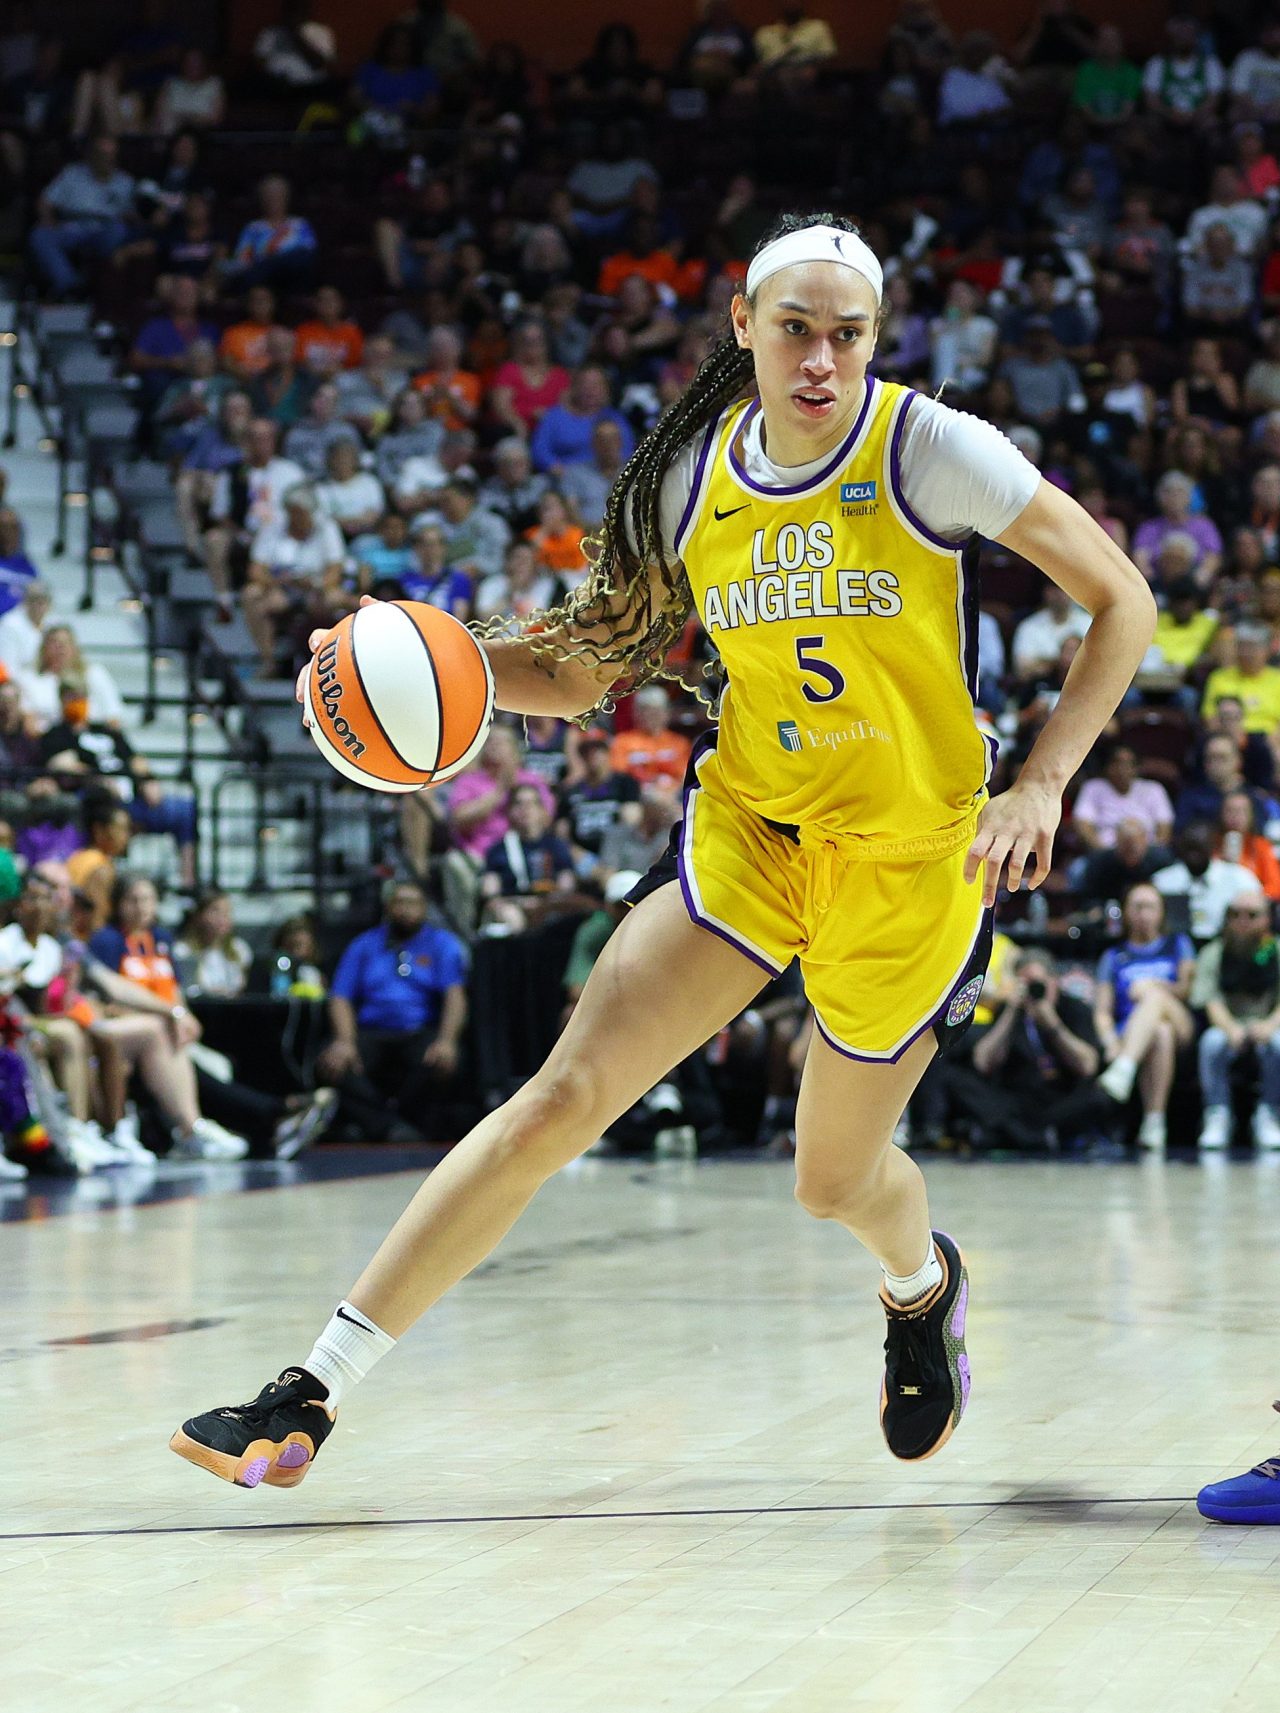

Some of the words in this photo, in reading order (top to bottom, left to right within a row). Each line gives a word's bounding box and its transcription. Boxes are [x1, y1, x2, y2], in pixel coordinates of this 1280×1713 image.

[845, 486, 872, 498] UCLA
[752, 521, 834, 575] LOS
[704, 570, 903, 633] ANGELES
[317, 635, 368, 760] Wilson
[794, 634, 847, 704] 5
